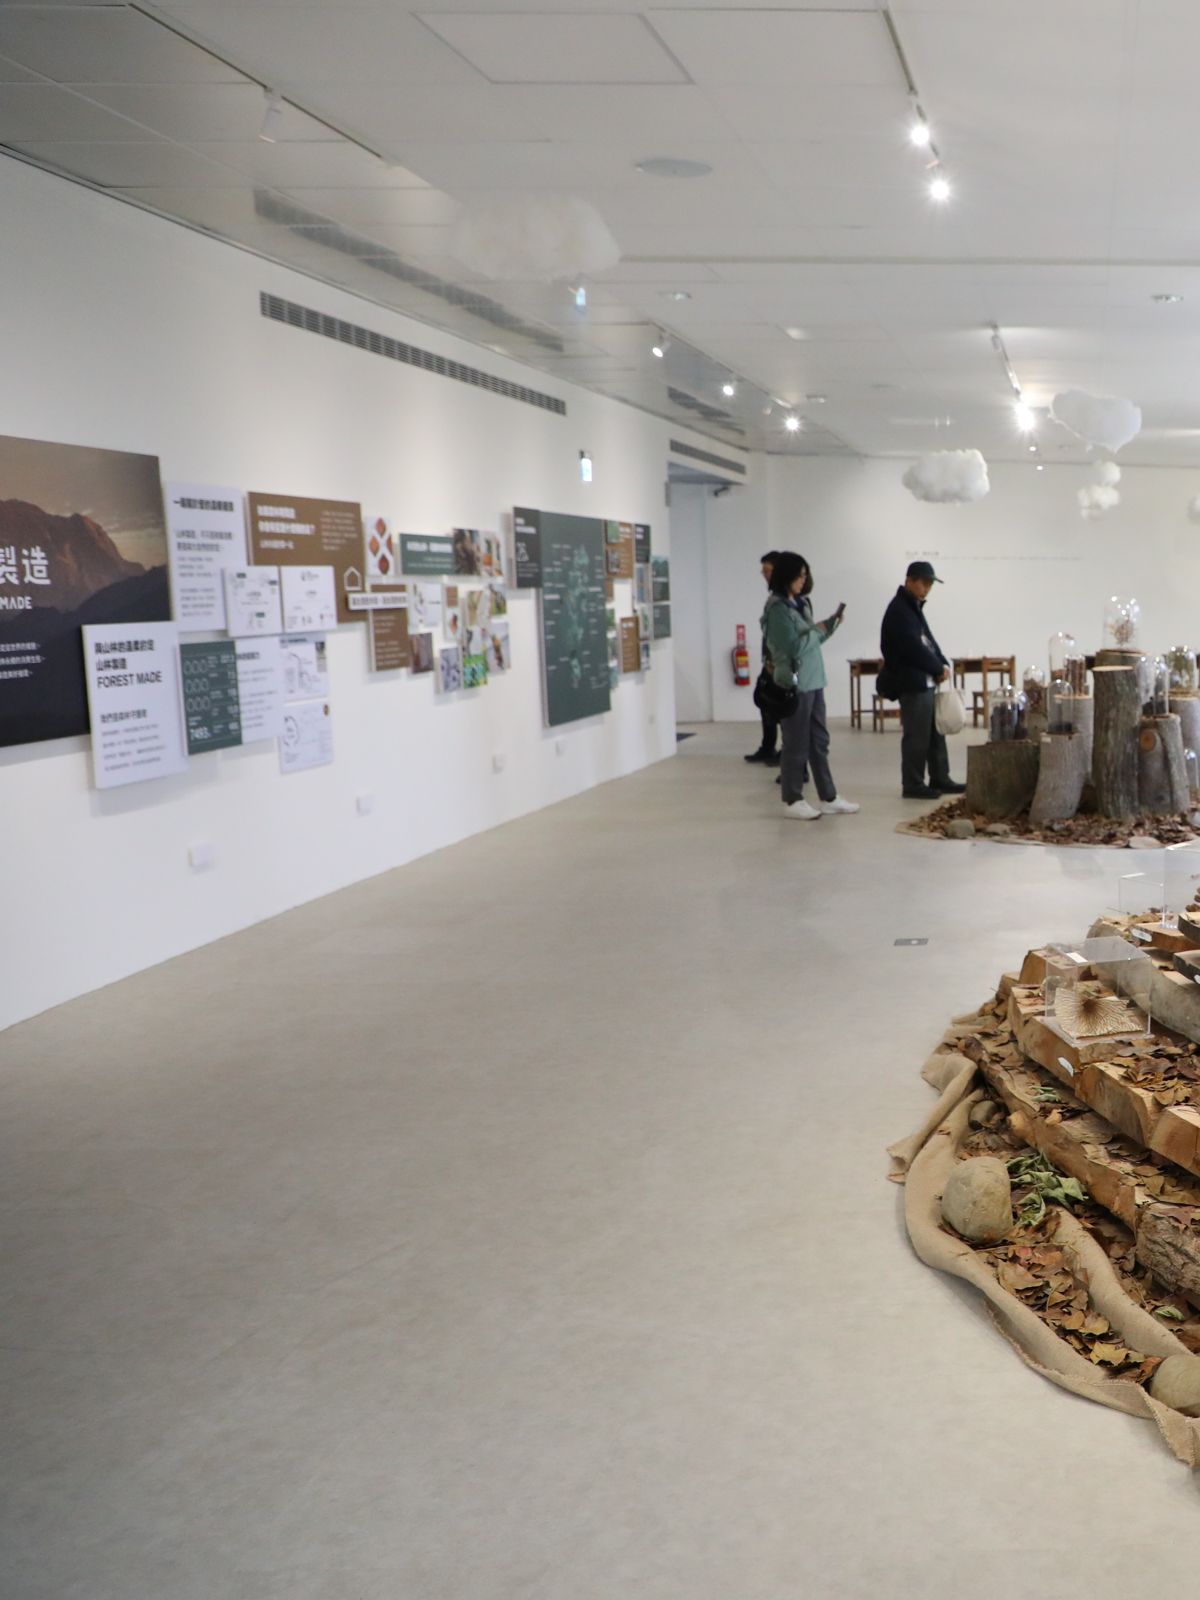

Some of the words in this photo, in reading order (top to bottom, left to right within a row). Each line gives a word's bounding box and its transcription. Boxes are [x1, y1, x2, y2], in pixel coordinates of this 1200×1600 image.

[0, 596, 32, 610] MADE
[97, 673, 134, 688] FOREST
[136, 671, 163, 685] MADE
